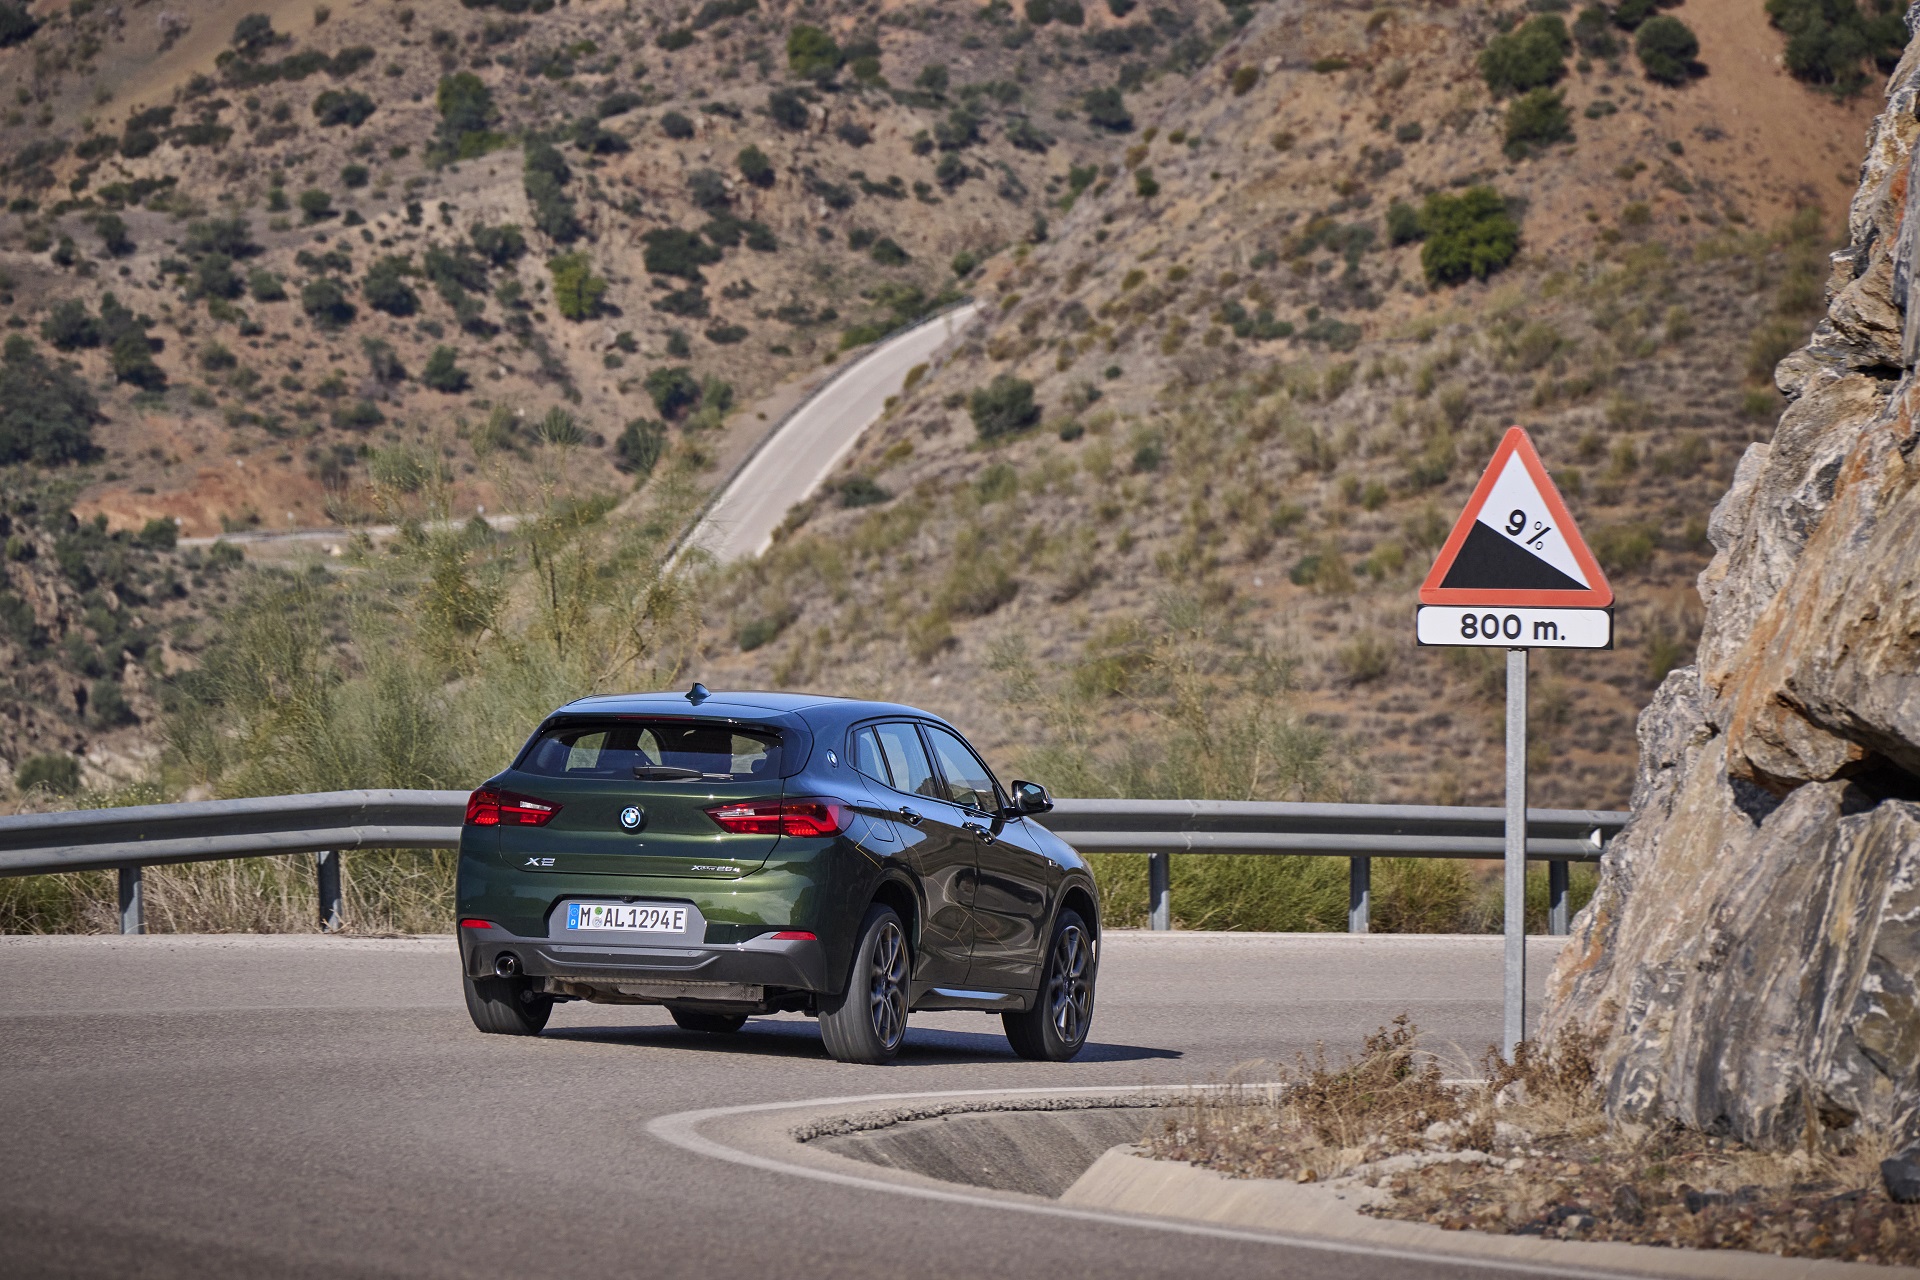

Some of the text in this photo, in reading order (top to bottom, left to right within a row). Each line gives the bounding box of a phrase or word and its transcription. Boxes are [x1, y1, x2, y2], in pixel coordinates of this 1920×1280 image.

[1505, 509, 1551, 550] 9%
[1461, 613, 1566, 640] 800 m.
[524, 857, 556, 867] X2
